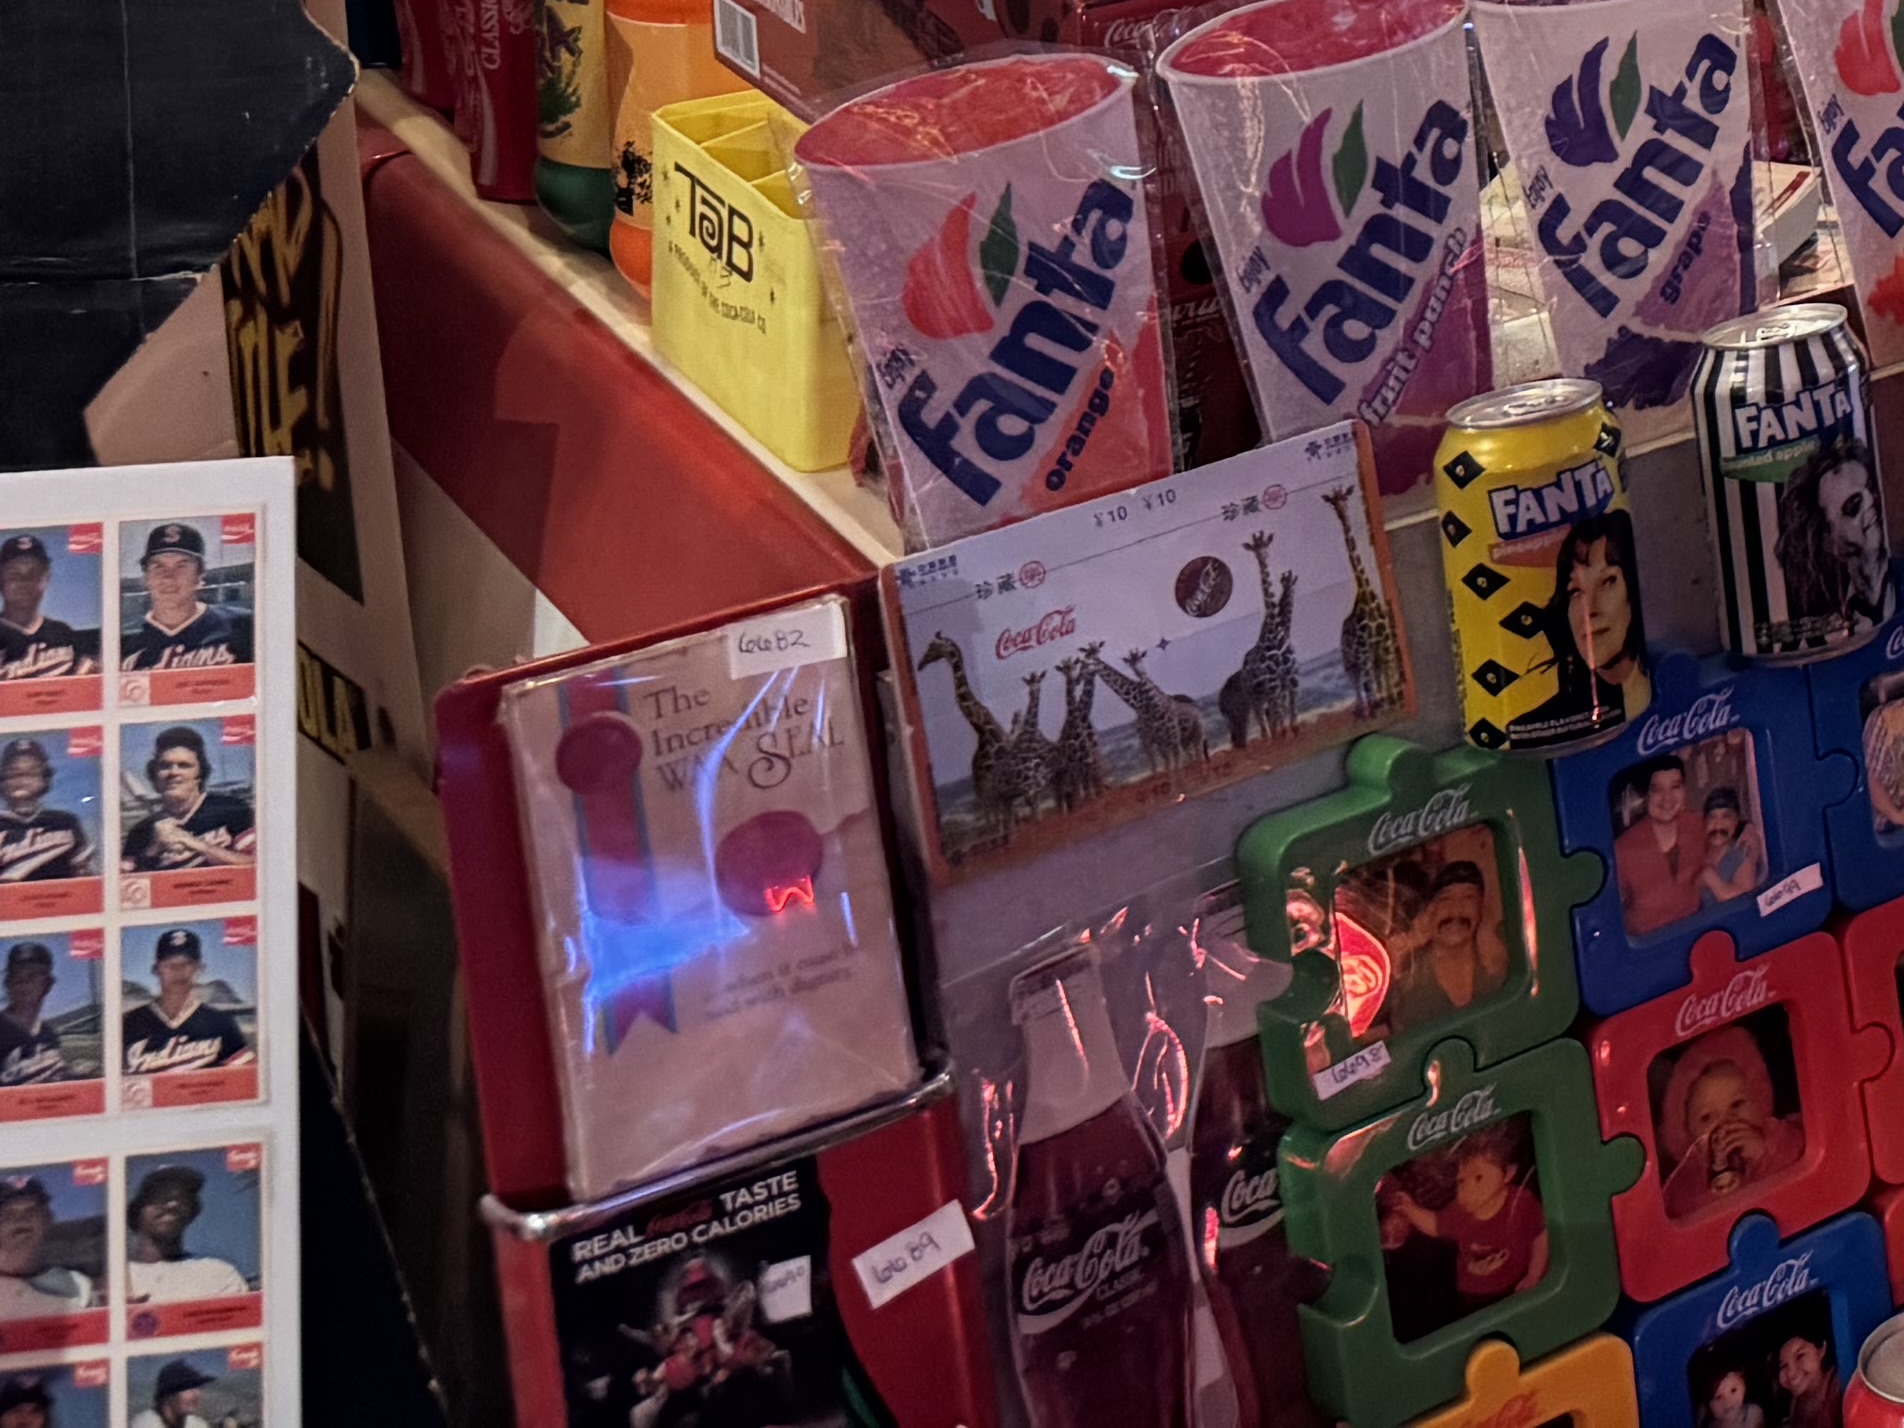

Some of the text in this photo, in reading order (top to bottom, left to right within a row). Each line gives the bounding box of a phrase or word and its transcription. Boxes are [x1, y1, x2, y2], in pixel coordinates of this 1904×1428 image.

[1818, 94, 1843, 138] Enjoy
[1526, 165, 1552, 209] Enjoy
[1537, 33, 1738, 320] Fanta
[1239, 246, 1267, 293] Enjoy
[1252, 98, 1469, 408] Fanta
[1659, 210, 1711, 307] grape
[898, 178, 1138, 506] Fanta
[1359, 227, 1468, 425] fruit punch
[879, 343, 913, 388] Enjoy
[1044, 368, 1114, 493] orange
[1735, 380, 1854, 451] FANTA
[1142, 488, 1177, 511] ¥10
[1221, 495, 1261, 522] 珍藏
[1489, 462, 1615, 539] FANTA
[736, 627, 811, 654] 6682
[643, 687, 710, 723] The
[573, 1172, 797, 1261] REAL TASTE
[576, 1193, 801, 1284] AND ZERO CALORIES
